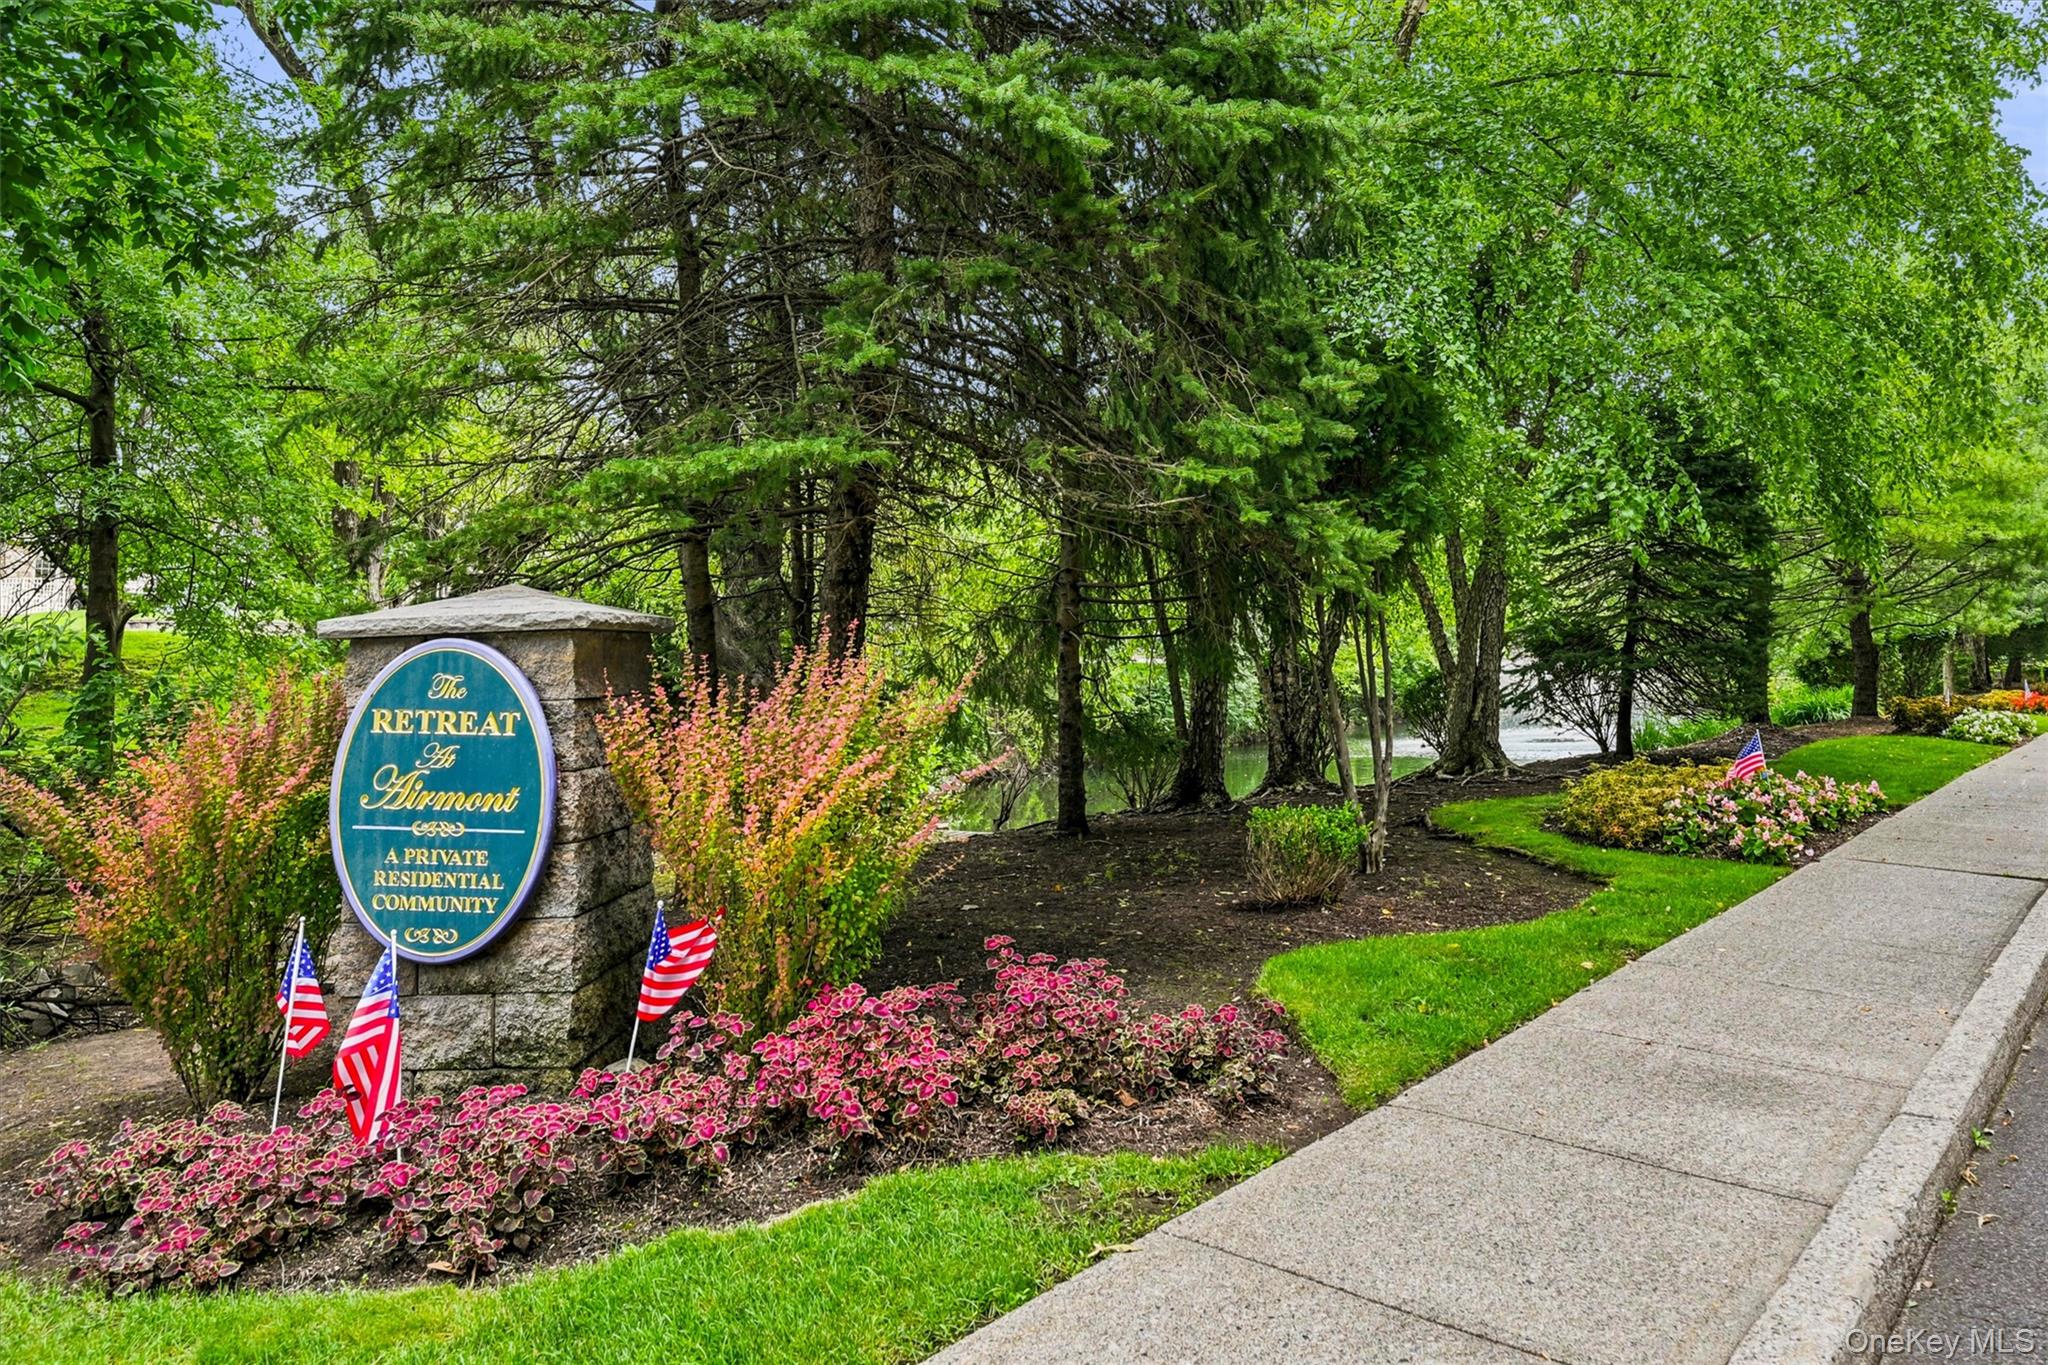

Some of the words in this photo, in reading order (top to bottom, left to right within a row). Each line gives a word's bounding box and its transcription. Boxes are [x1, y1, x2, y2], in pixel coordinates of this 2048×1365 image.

[428, 672, 467, 700] The
[370, 708, 521, 736] RETREAT
[415, 742, 460, 769] At
[360, 764, 520, 813] Airmont
[385, 848, 398, 864] A
[404, 848, 489, 867] PRIVATE
[373, 870, 504, 890] RESIDENTIAL
[373, 895, 498, 913] COMMUNITY
